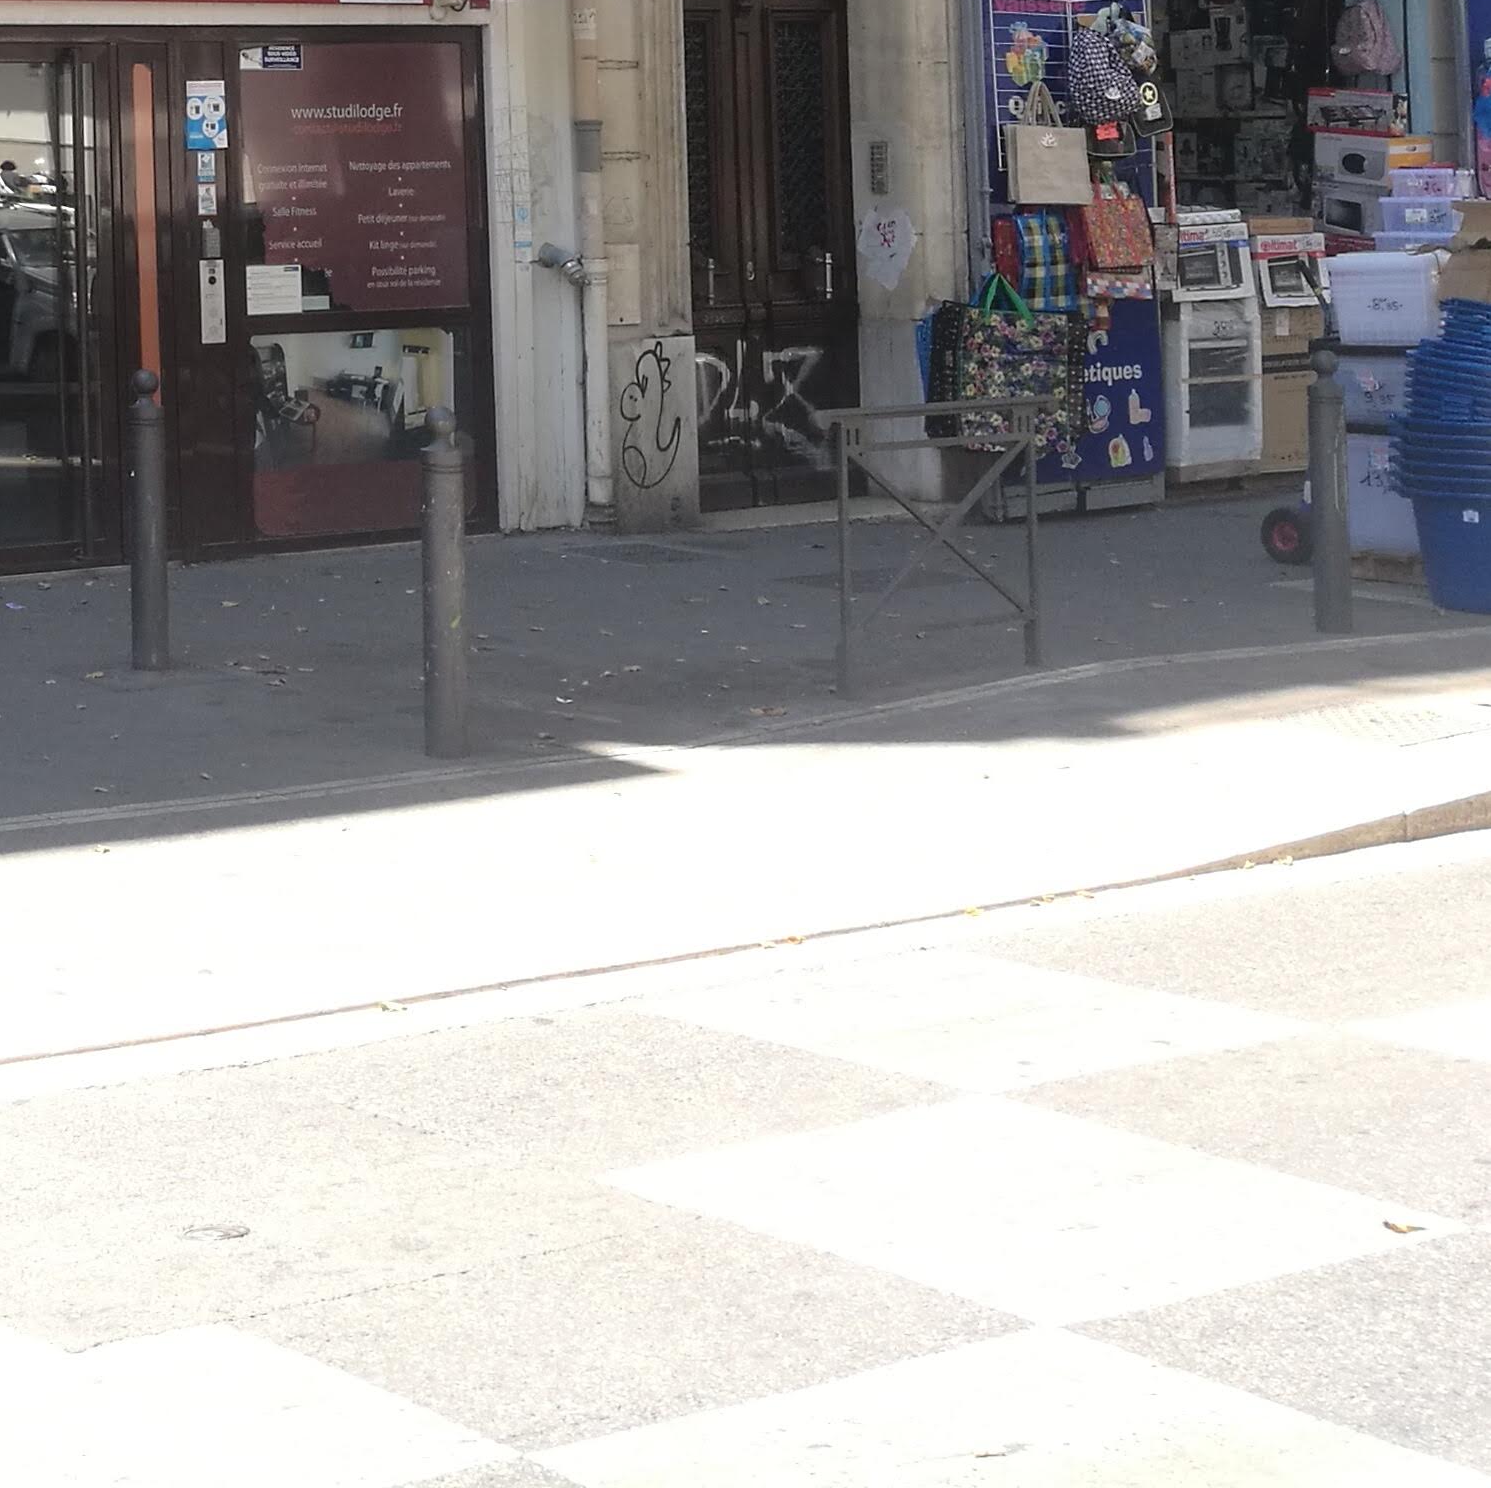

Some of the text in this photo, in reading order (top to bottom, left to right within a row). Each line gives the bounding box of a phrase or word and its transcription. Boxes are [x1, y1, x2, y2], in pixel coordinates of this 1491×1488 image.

[291, 102, 404, 121] www.studilodge.fr
[349, 160, 451, 172] Nettoyage des appartements
[291, 207, 317, 216] Fitness
[269, 238, 323, 250] Service accueil
[369, 240, 379, 250] Kit
[372, 265, 436, 277] Possibilité parking
